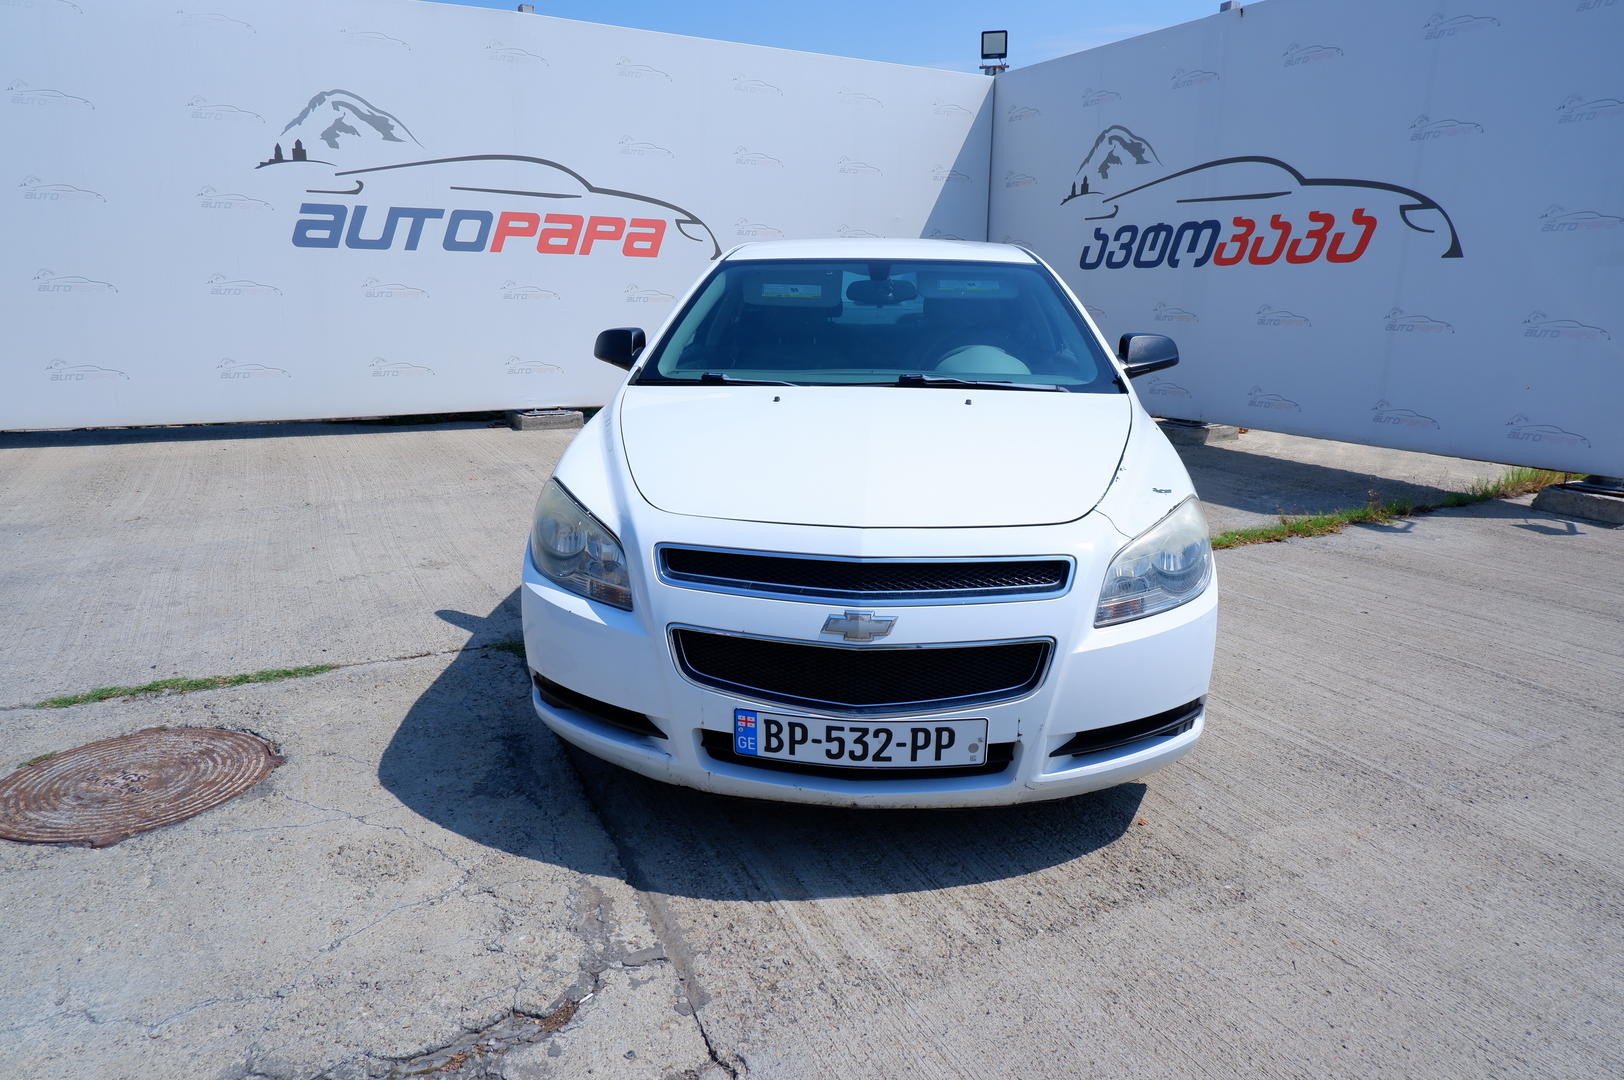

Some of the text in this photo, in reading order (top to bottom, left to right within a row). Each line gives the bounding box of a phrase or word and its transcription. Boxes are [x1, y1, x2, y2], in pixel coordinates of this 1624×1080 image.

[1079, 208, 1378, 270] ავტოპაპა
[737, 736, 755, 750] GE
[763, 718, 956, 762] BP-532-PP
